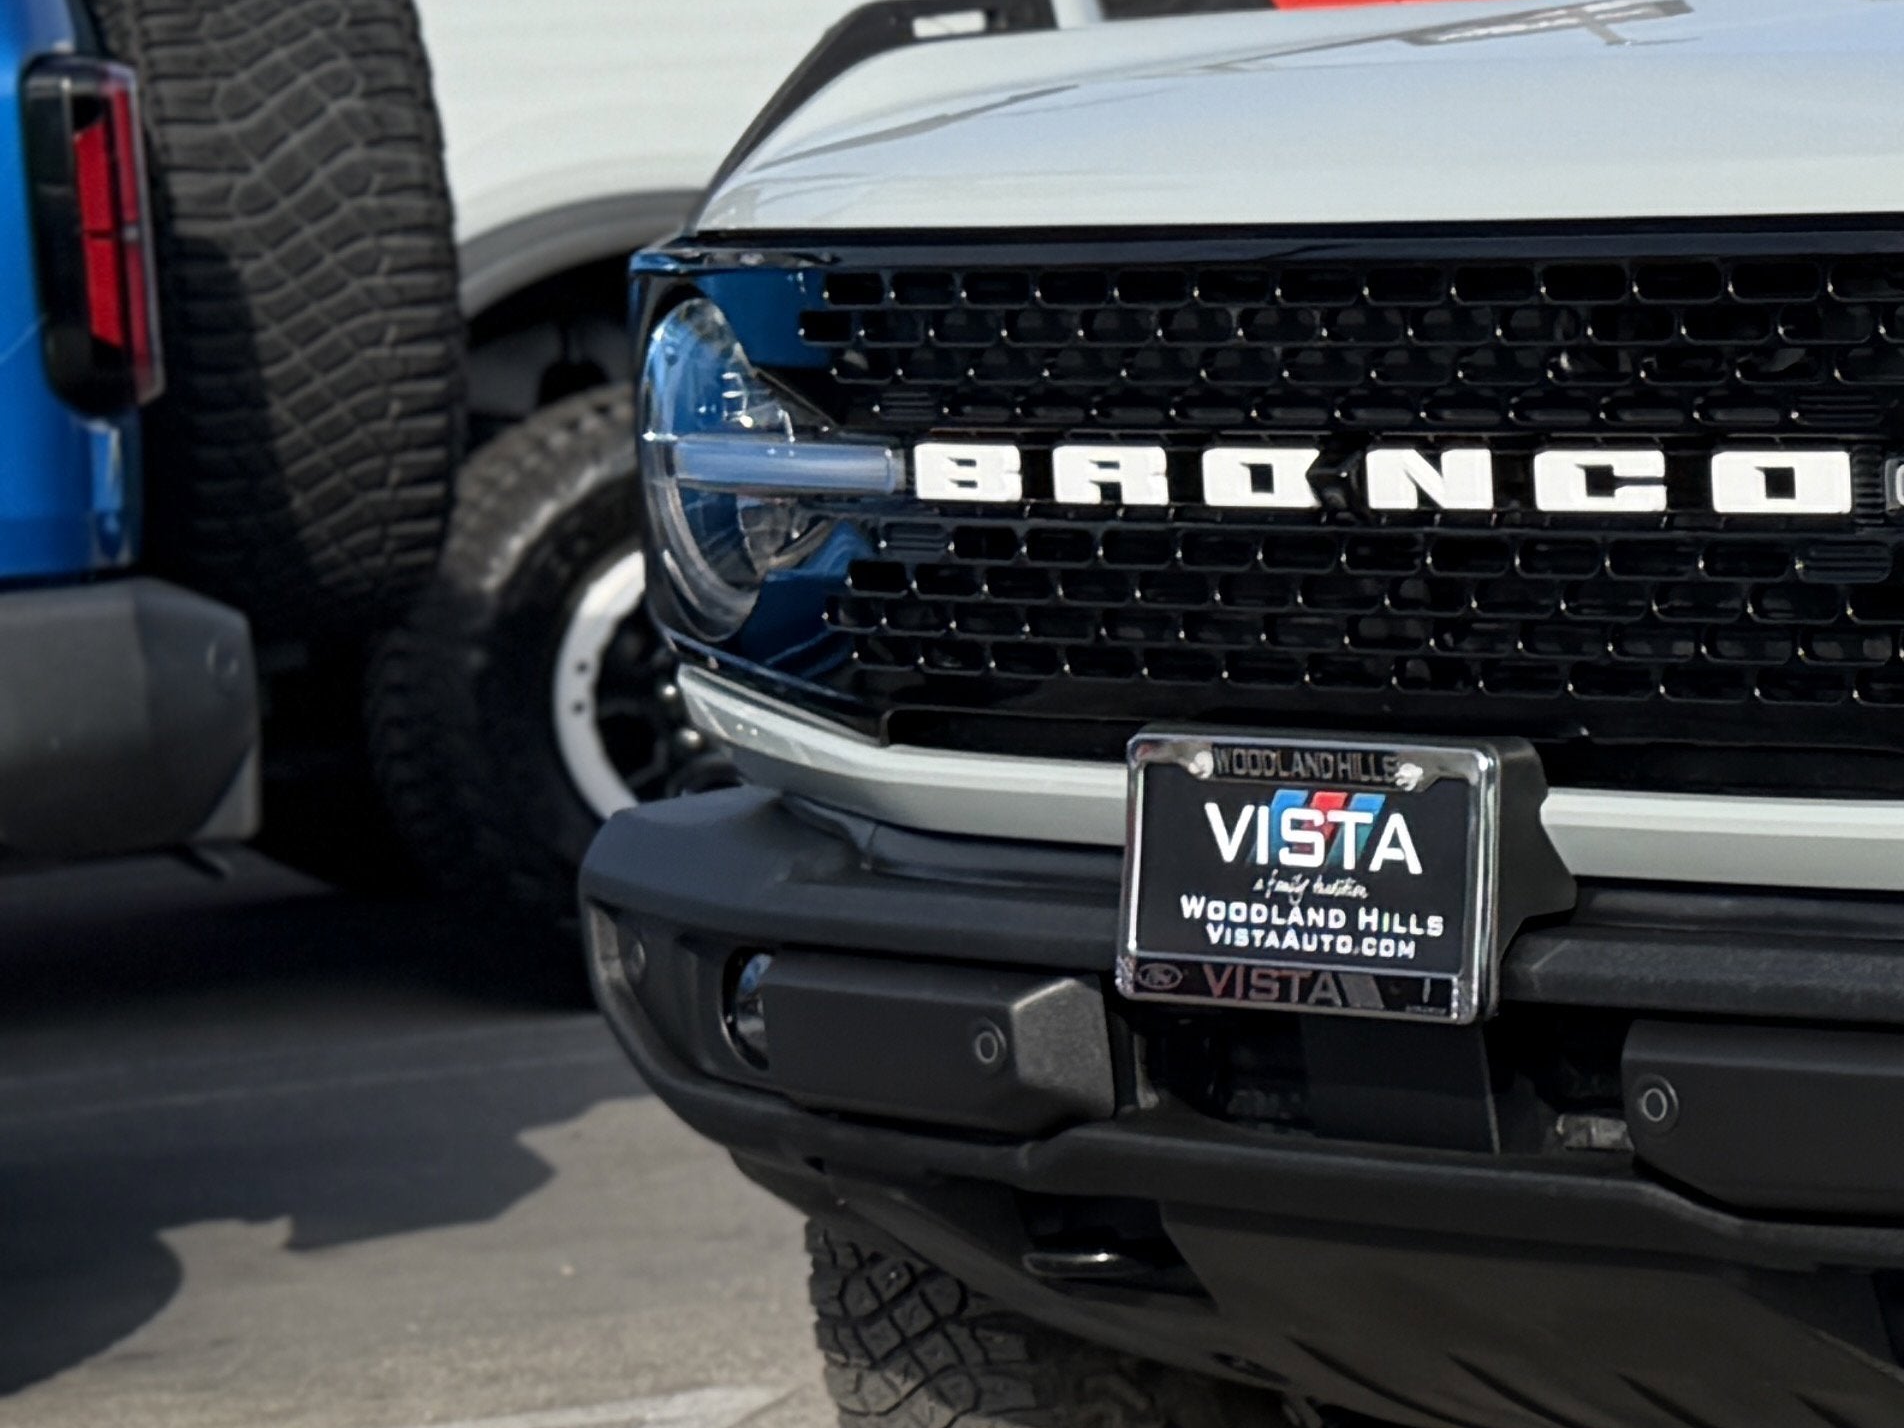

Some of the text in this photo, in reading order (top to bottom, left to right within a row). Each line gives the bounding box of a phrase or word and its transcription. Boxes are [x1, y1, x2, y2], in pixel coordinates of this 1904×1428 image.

[912, 442, 1852, 515] BRONCO
[1213, 745, 1400, 784] WOODLAND HILLS
[1204, 802, 1423, 875] VISTA
[1201, 963, 1342, 1008] VISTA
